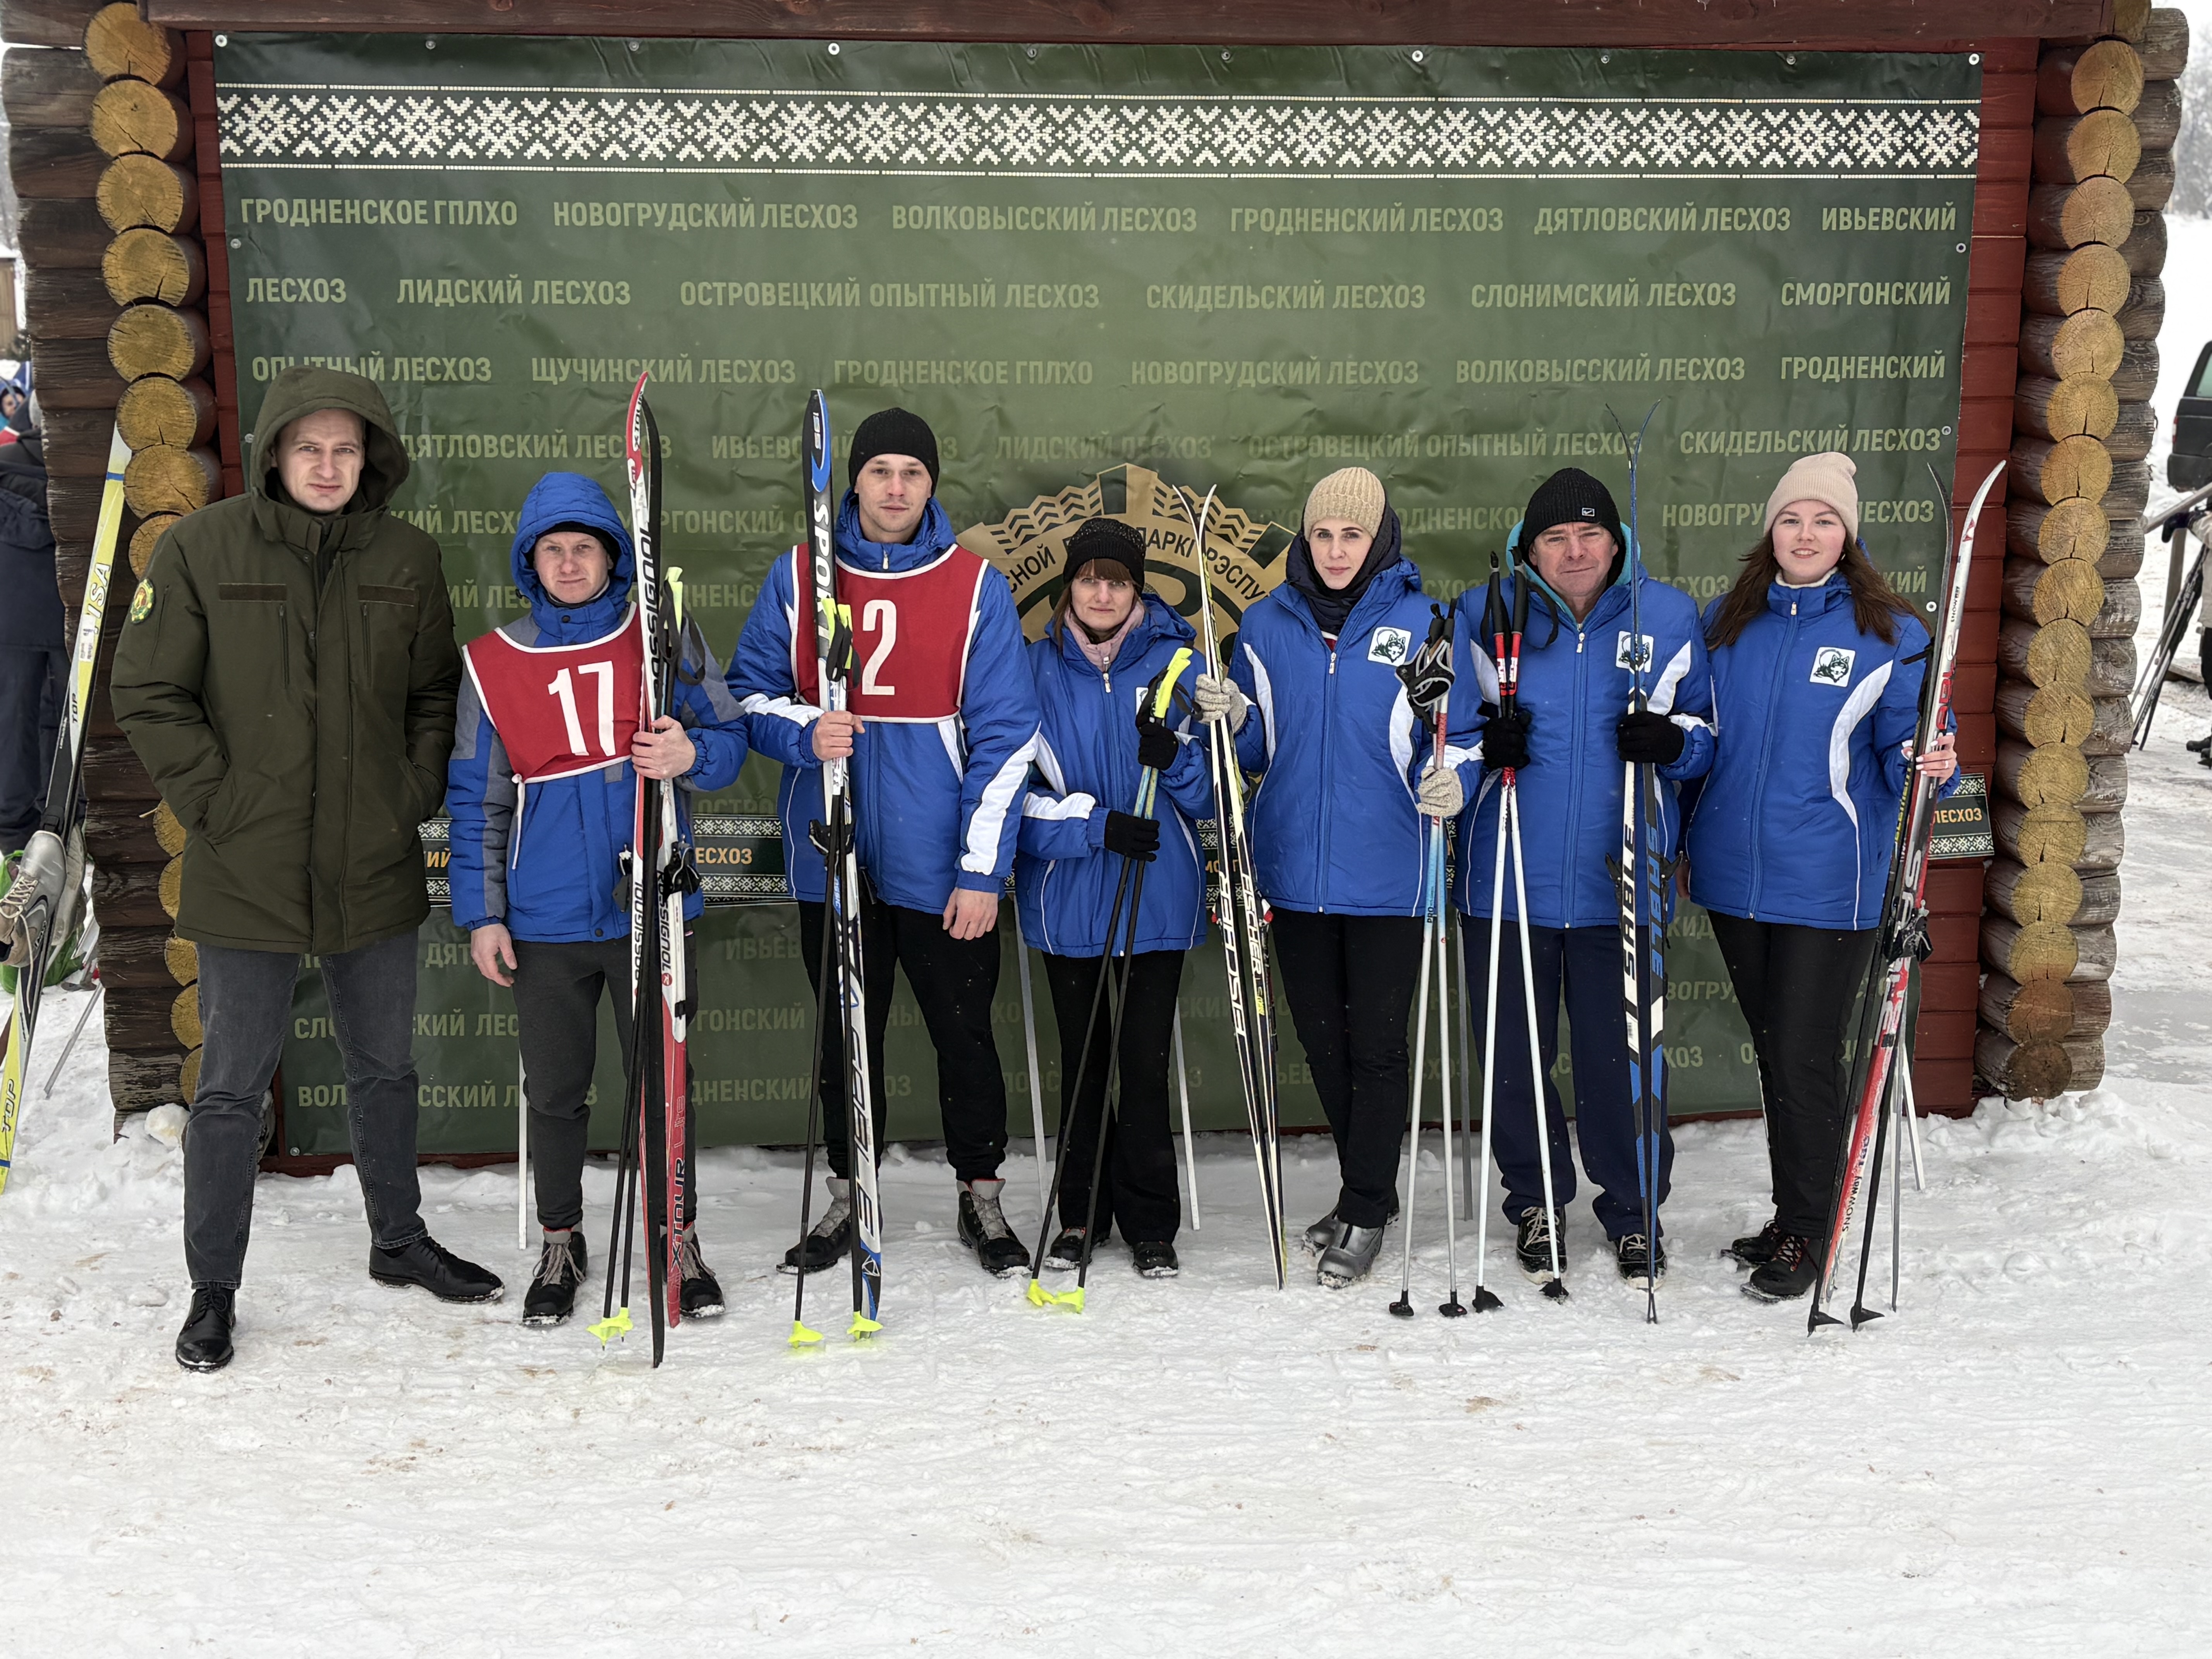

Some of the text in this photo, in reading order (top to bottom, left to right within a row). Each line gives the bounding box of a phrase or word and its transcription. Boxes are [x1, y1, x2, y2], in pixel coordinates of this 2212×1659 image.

[241, 197, 1956, 235] ГРОДНЕНСКОЕ ГПЛХО НОВОГРУДСКИЙ ЛЕСХОЗ ВОЛКОВЫССКИЙ ЛЕСХОЗ ГРОДНЕНСКИЙ ЛЕСХОЗ ДЯТЛОВСКИЙ ЛЕСХОЗ ИВЬЕВСКИЙ
[246, 275, 1950, 312] ЛЕСХОЗ ЛИДСКИЙ ЛЕСХОЗ ОСТРОВЕЦКИЙ ОПЫТНЫЙ ЛЕСХОЗ СКИДЕЛЬСКИЙ ЛЕСХОЗ СЛОНИМСКИЙ ЛЕСХОЗ СМОРГОНСКИЙ
[392, 357, 491, 382] ЛЕСХОЗ
[532, 353, 692, 385] ЩУЧИНСКИЙ
[699, 359, 796, 383] ЛЕСХОЗ
[834, 360, 1007, 387] ГРОДНЕНСКОЕ
[1016, 361, 1093, 384] ГПЛХО
[1132, 355, 1321, 387] НОВОГРУДСКИЙ
[1326, 360, 1419, 384] ЛЕСХОЗ
[1456, 353, 1650, 383] ВОЛКОВЫССКИЙ
[1656, 357, 1745, 382] ЛЕСХОЗ
[1781, 350, 1946, 383] ГРОДНЕНСКИЙ
[995, 431, 1113, 460] ЛИДСКИЙ
[1122, 436, 1212, 459] ЛЕСХОЗ
[1249, 429, 1420, 461] ОСТРОВЕЦКИЙ
[1426, 428, 1546, 458] ОПЫТНЫЙ
[1553, 432, 1643, 456] ЛЕСХОЗ
[1680, 424, 1849, 456] СКИДЕЛЬСКИЙ
[1853, 428, 1941, 451] ЛЕСХОЗ
[451, 510, 518, 534] ЛЕСХ
[1662, 503, 1767, 526] НОВОГРУ
[862, 599, 897, 696] 2
[547, 660, 616, 756] 17
[695, 847, 752, 864] ЕСХОЗ
[1623, 823, 1637, 981] SABLE
[1646, 822, 1663, 979] SABLE
[1242, 873, 1262, 975] FISCHER
[726, 937, 801, 960] ИВЬЕВ
[697, 1002, 805, 1032] ГОНСКИЙ
